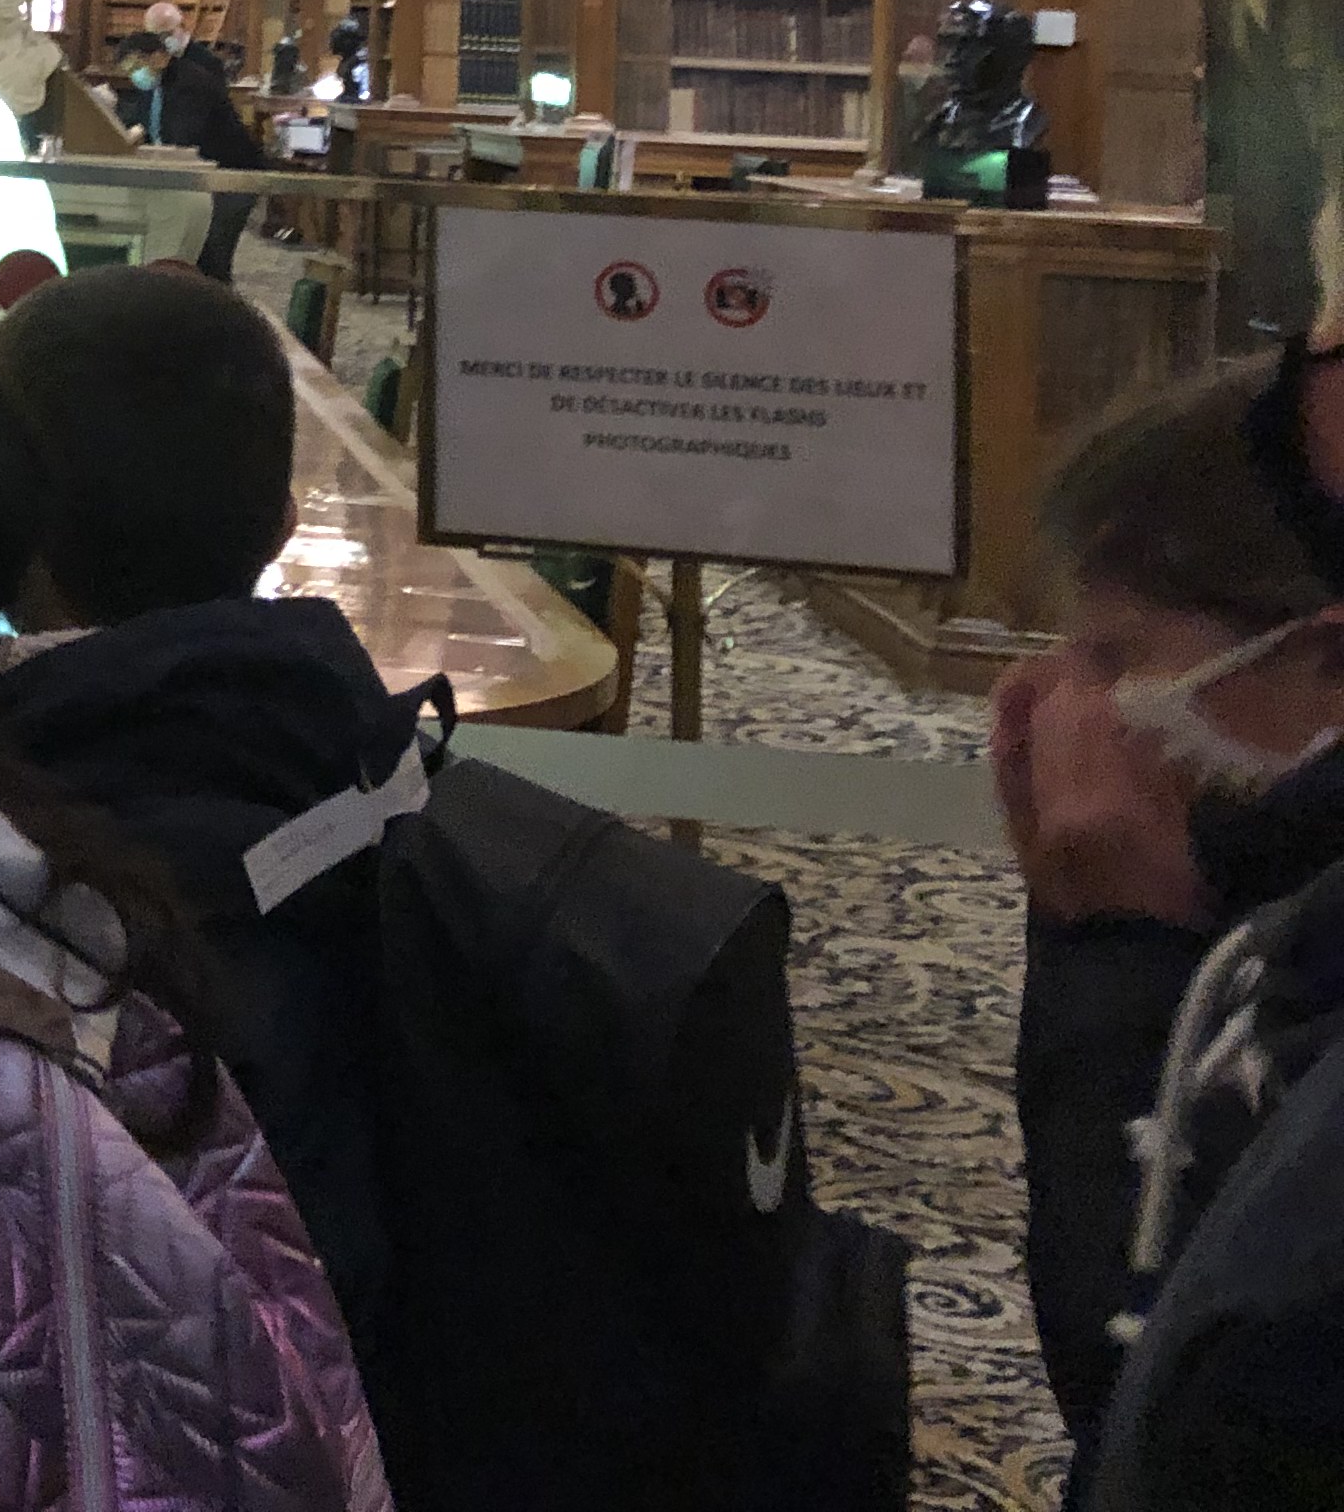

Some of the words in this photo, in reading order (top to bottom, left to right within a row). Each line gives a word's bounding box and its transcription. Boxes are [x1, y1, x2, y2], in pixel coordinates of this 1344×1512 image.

[460, 359, 522, 378] MERCI
[528, 361, 551, 379] DE
[559, 364, 667, 386] RESPECTER
[675, 369, 693, 388] LE
[702, 371, 780, 392] SILENCE
[790, 376, 829, 395] DES
[835, 378, 896, 398] LIEUX
[903, 381, 927, 400] ET
[551, 394, 576, 413] DE
[710, 403, 743, 422] LES
[583, 432, 792, 460] PHOTOGRAPHIQUES
